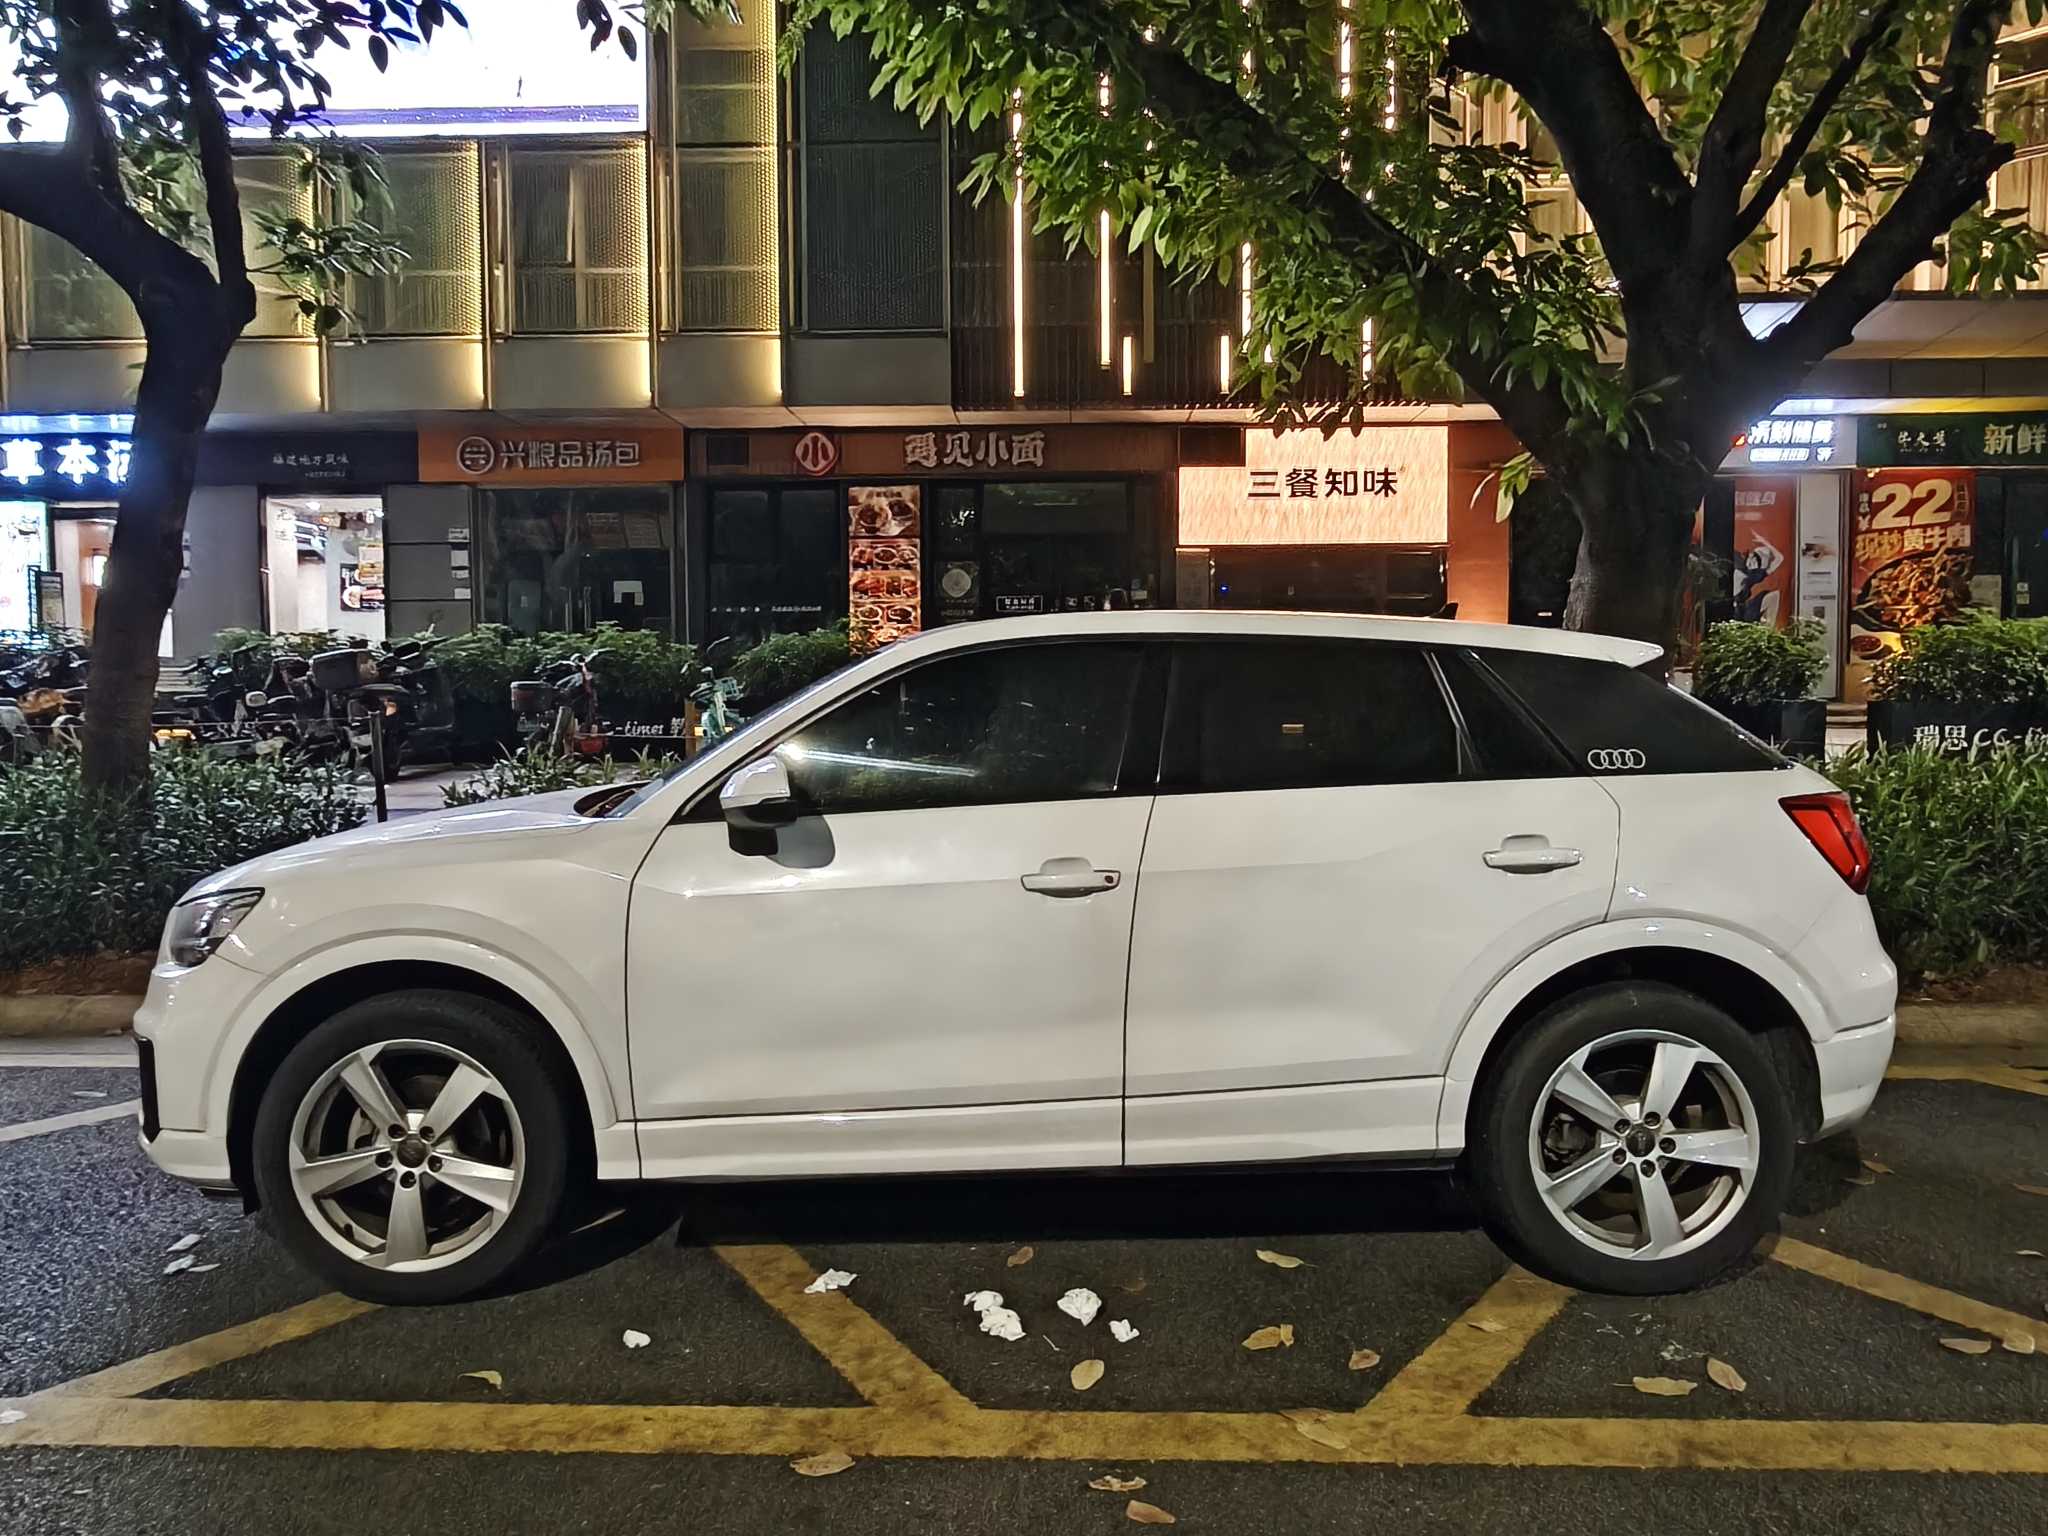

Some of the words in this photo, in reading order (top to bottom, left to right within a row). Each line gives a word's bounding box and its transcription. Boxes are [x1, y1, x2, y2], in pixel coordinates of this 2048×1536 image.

[904, 431, 1046, 468] 遇见小面
[1983, 423, 2048, 456] 新鲜
[1247, 467, 1398, 498] 三餐知味
[1871, 478, 1953, 529] 22
